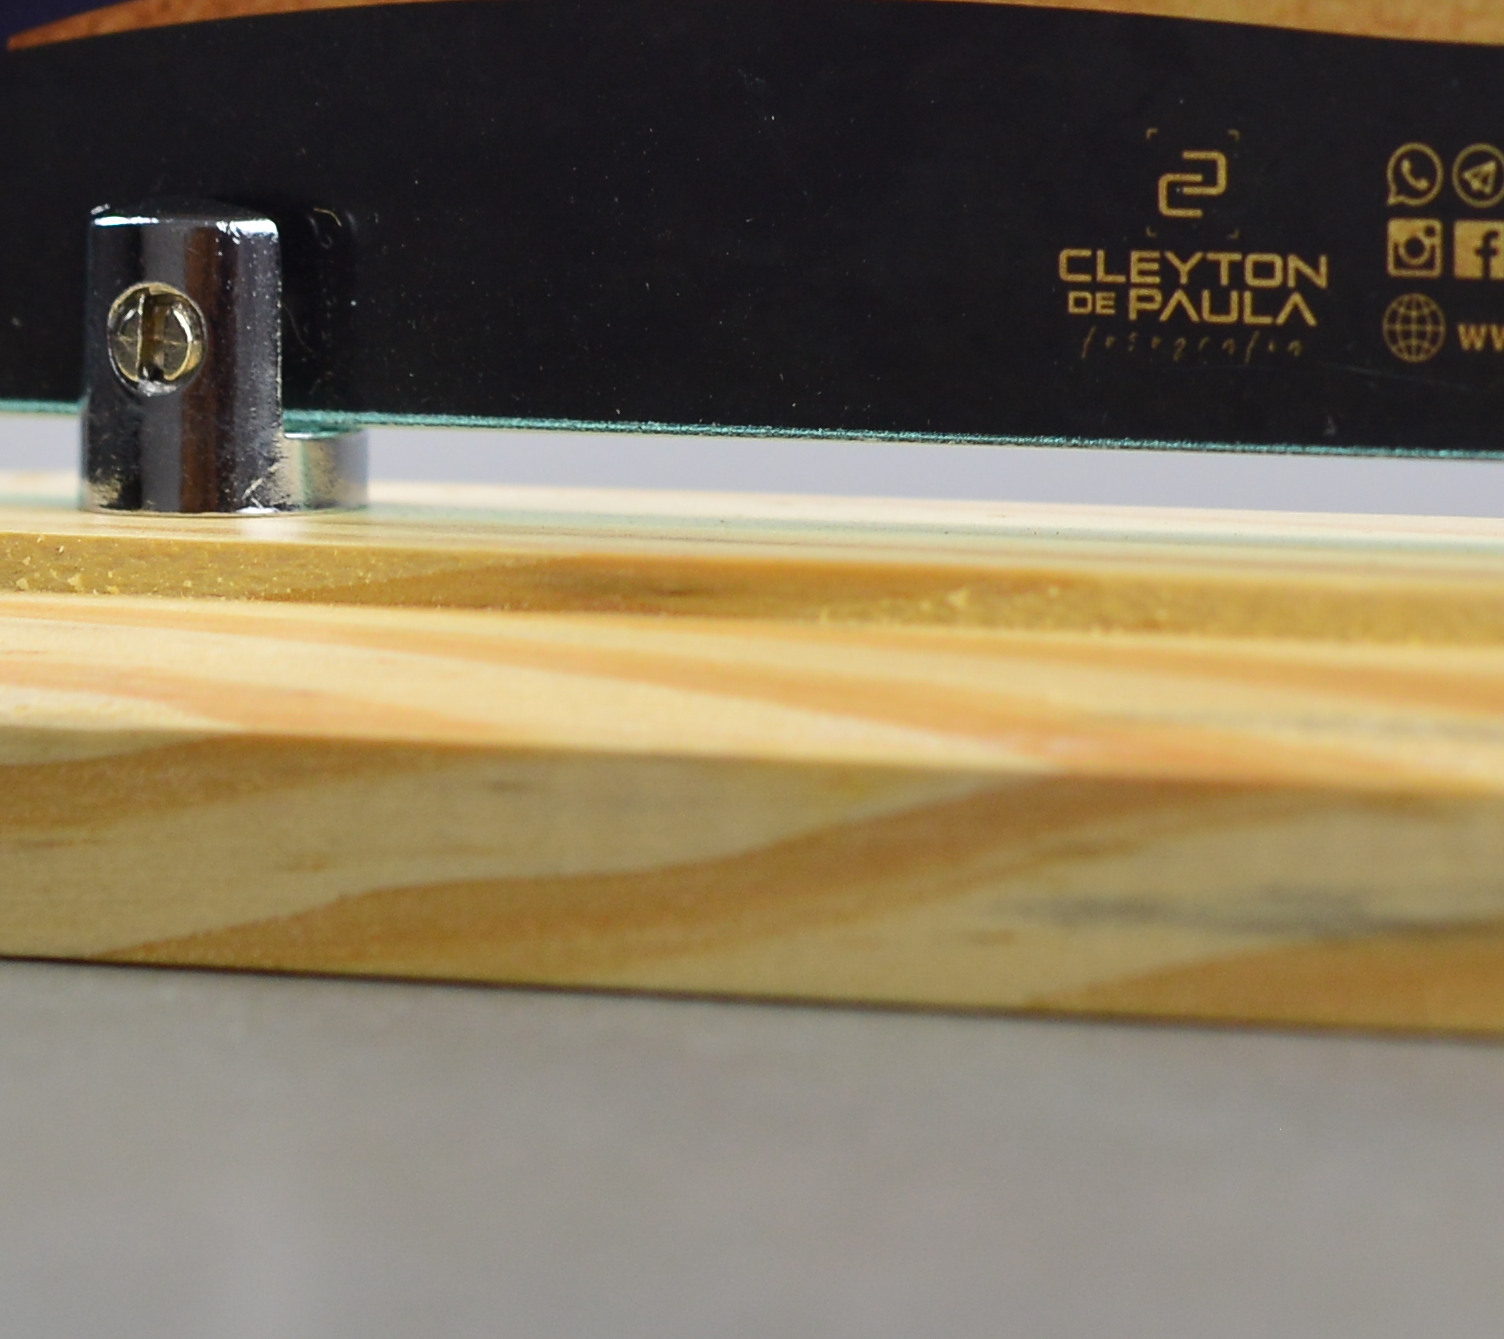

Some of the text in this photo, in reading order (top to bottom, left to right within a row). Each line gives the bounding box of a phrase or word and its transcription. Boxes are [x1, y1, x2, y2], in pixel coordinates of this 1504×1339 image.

[1058, 248, 1328, 289] CLEYTON
[1067, 287, 1317, 326] DE PAULA
